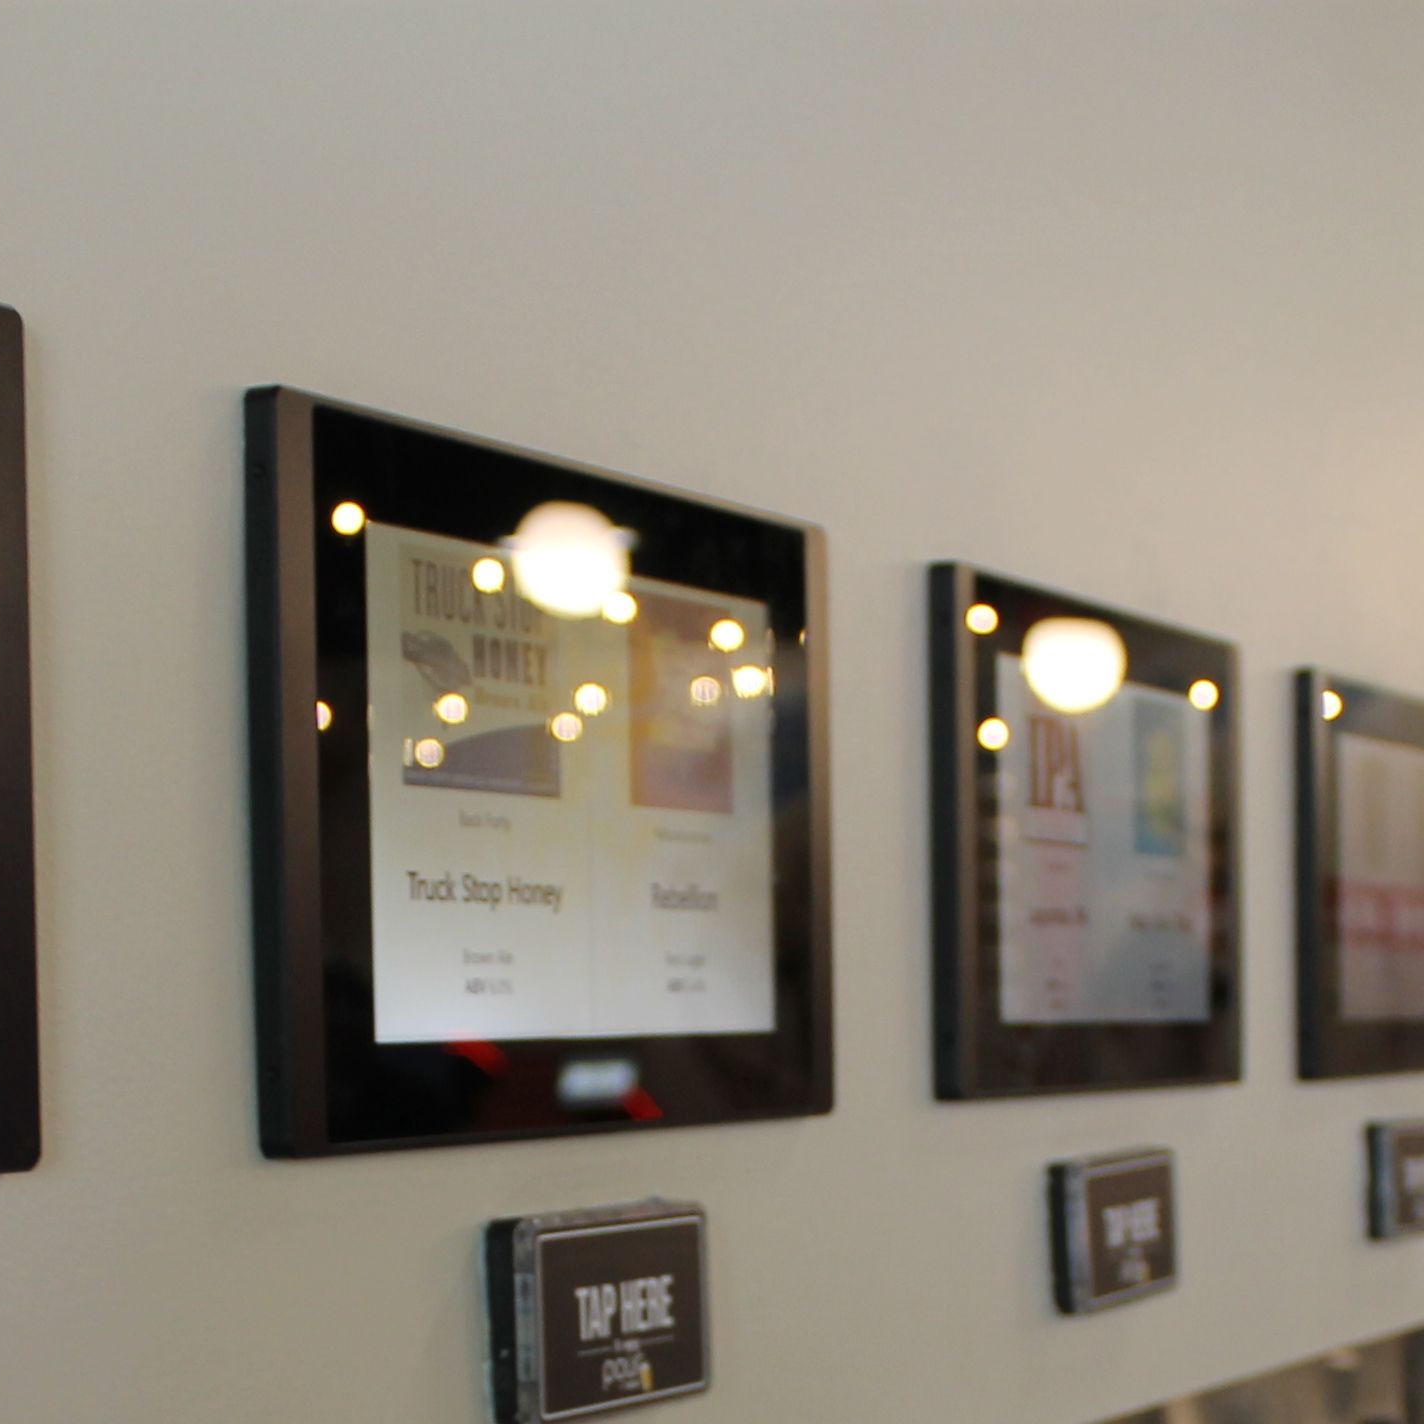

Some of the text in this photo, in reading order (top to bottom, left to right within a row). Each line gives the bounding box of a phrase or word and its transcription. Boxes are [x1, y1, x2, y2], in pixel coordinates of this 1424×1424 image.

[405, 870, 562, 914] Truck Stop Honey
[574, 1274, 675, 1342] TAP HERE
